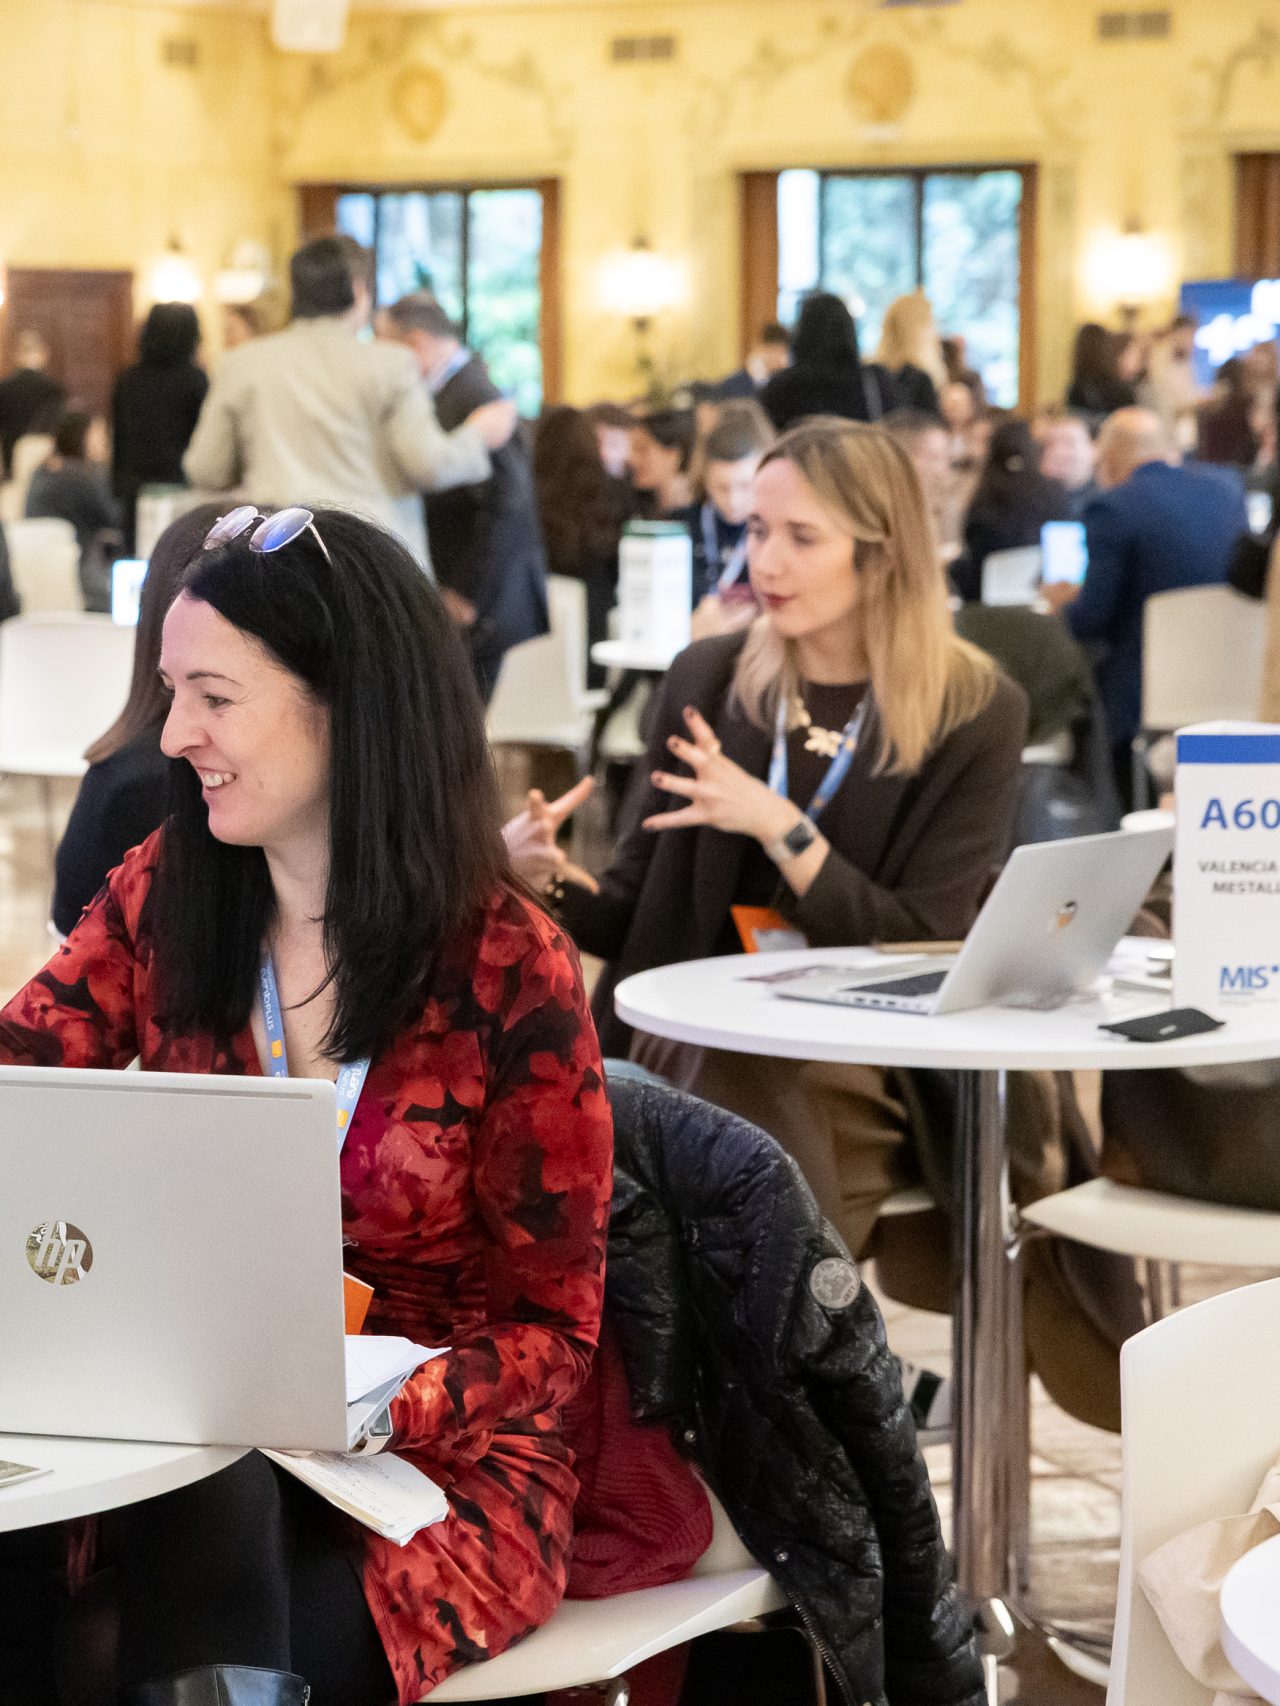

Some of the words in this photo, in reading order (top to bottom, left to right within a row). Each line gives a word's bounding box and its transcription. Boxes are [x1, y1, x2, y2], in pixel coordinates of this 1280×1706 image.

[1198, 860, 1277, 873] VALENCIA
[1220, 966, 1269, 989] MIS
[34, 1221, 88, 1285] hp
